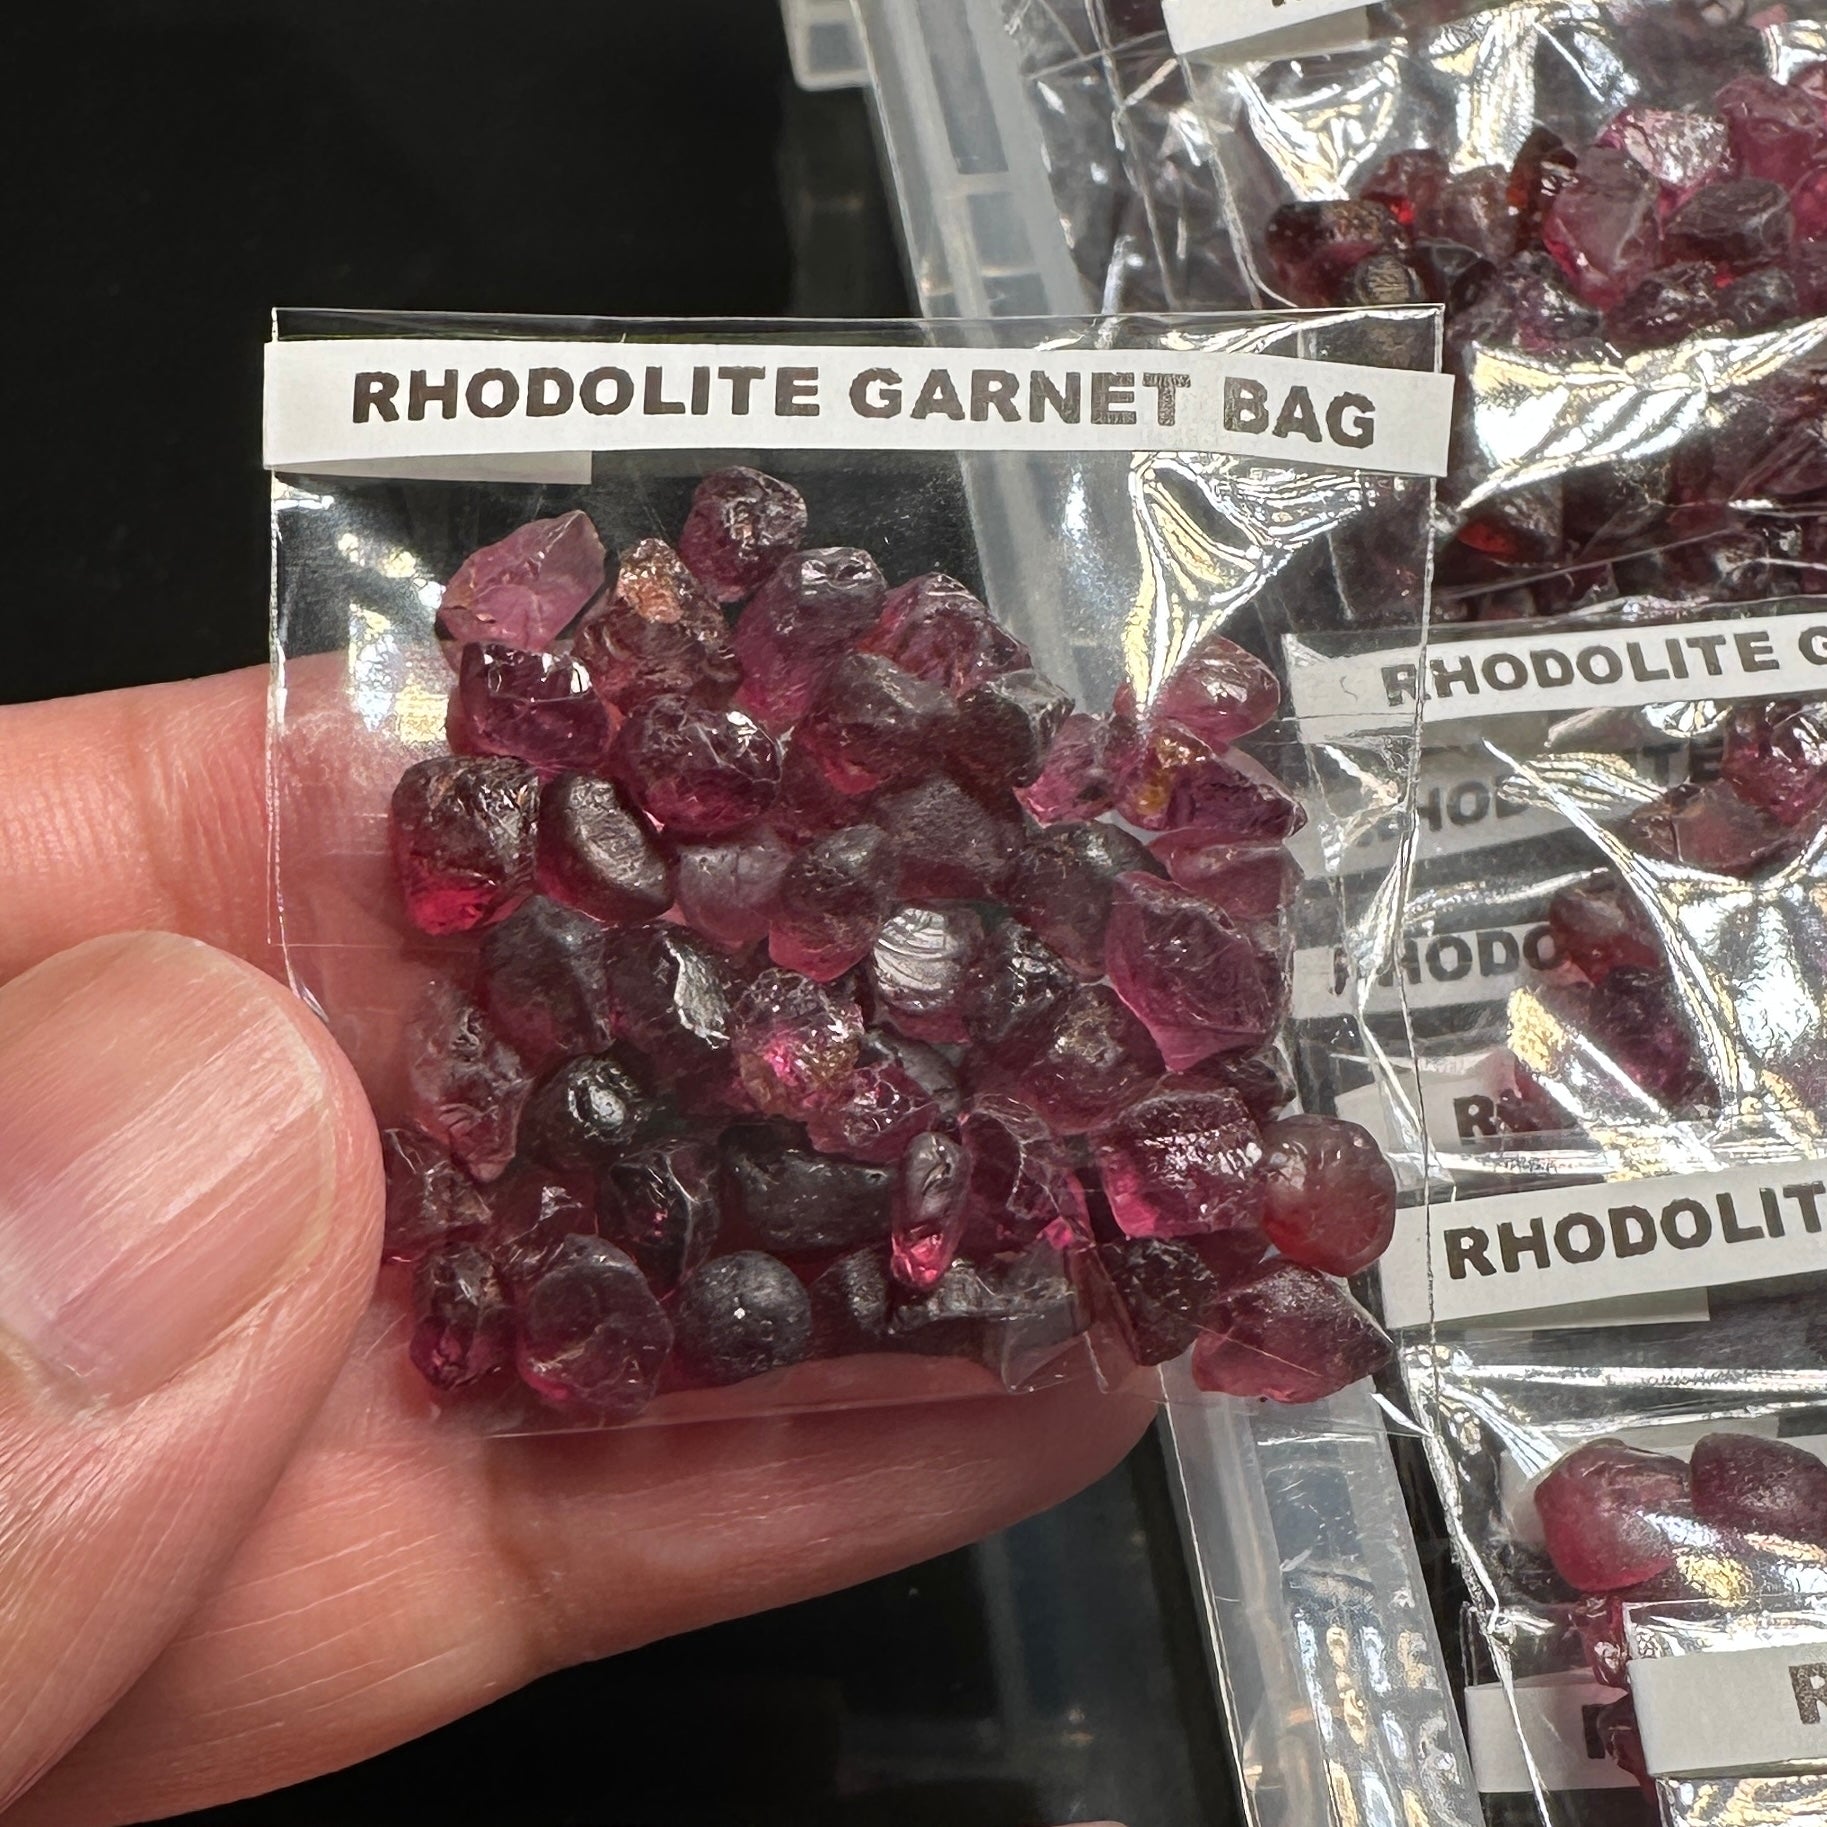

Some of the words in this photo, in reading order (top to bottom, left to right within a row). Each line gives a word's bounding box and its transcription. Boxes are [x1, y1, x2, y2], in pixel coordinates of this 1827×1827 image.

[352, 366, 820, 424] RHODOLITE
[849, 367, 1192, 428] GARNET
[1224, 375, 1376, 450] BAG
[1380, 630, 1780, 707] RHODOLITE
